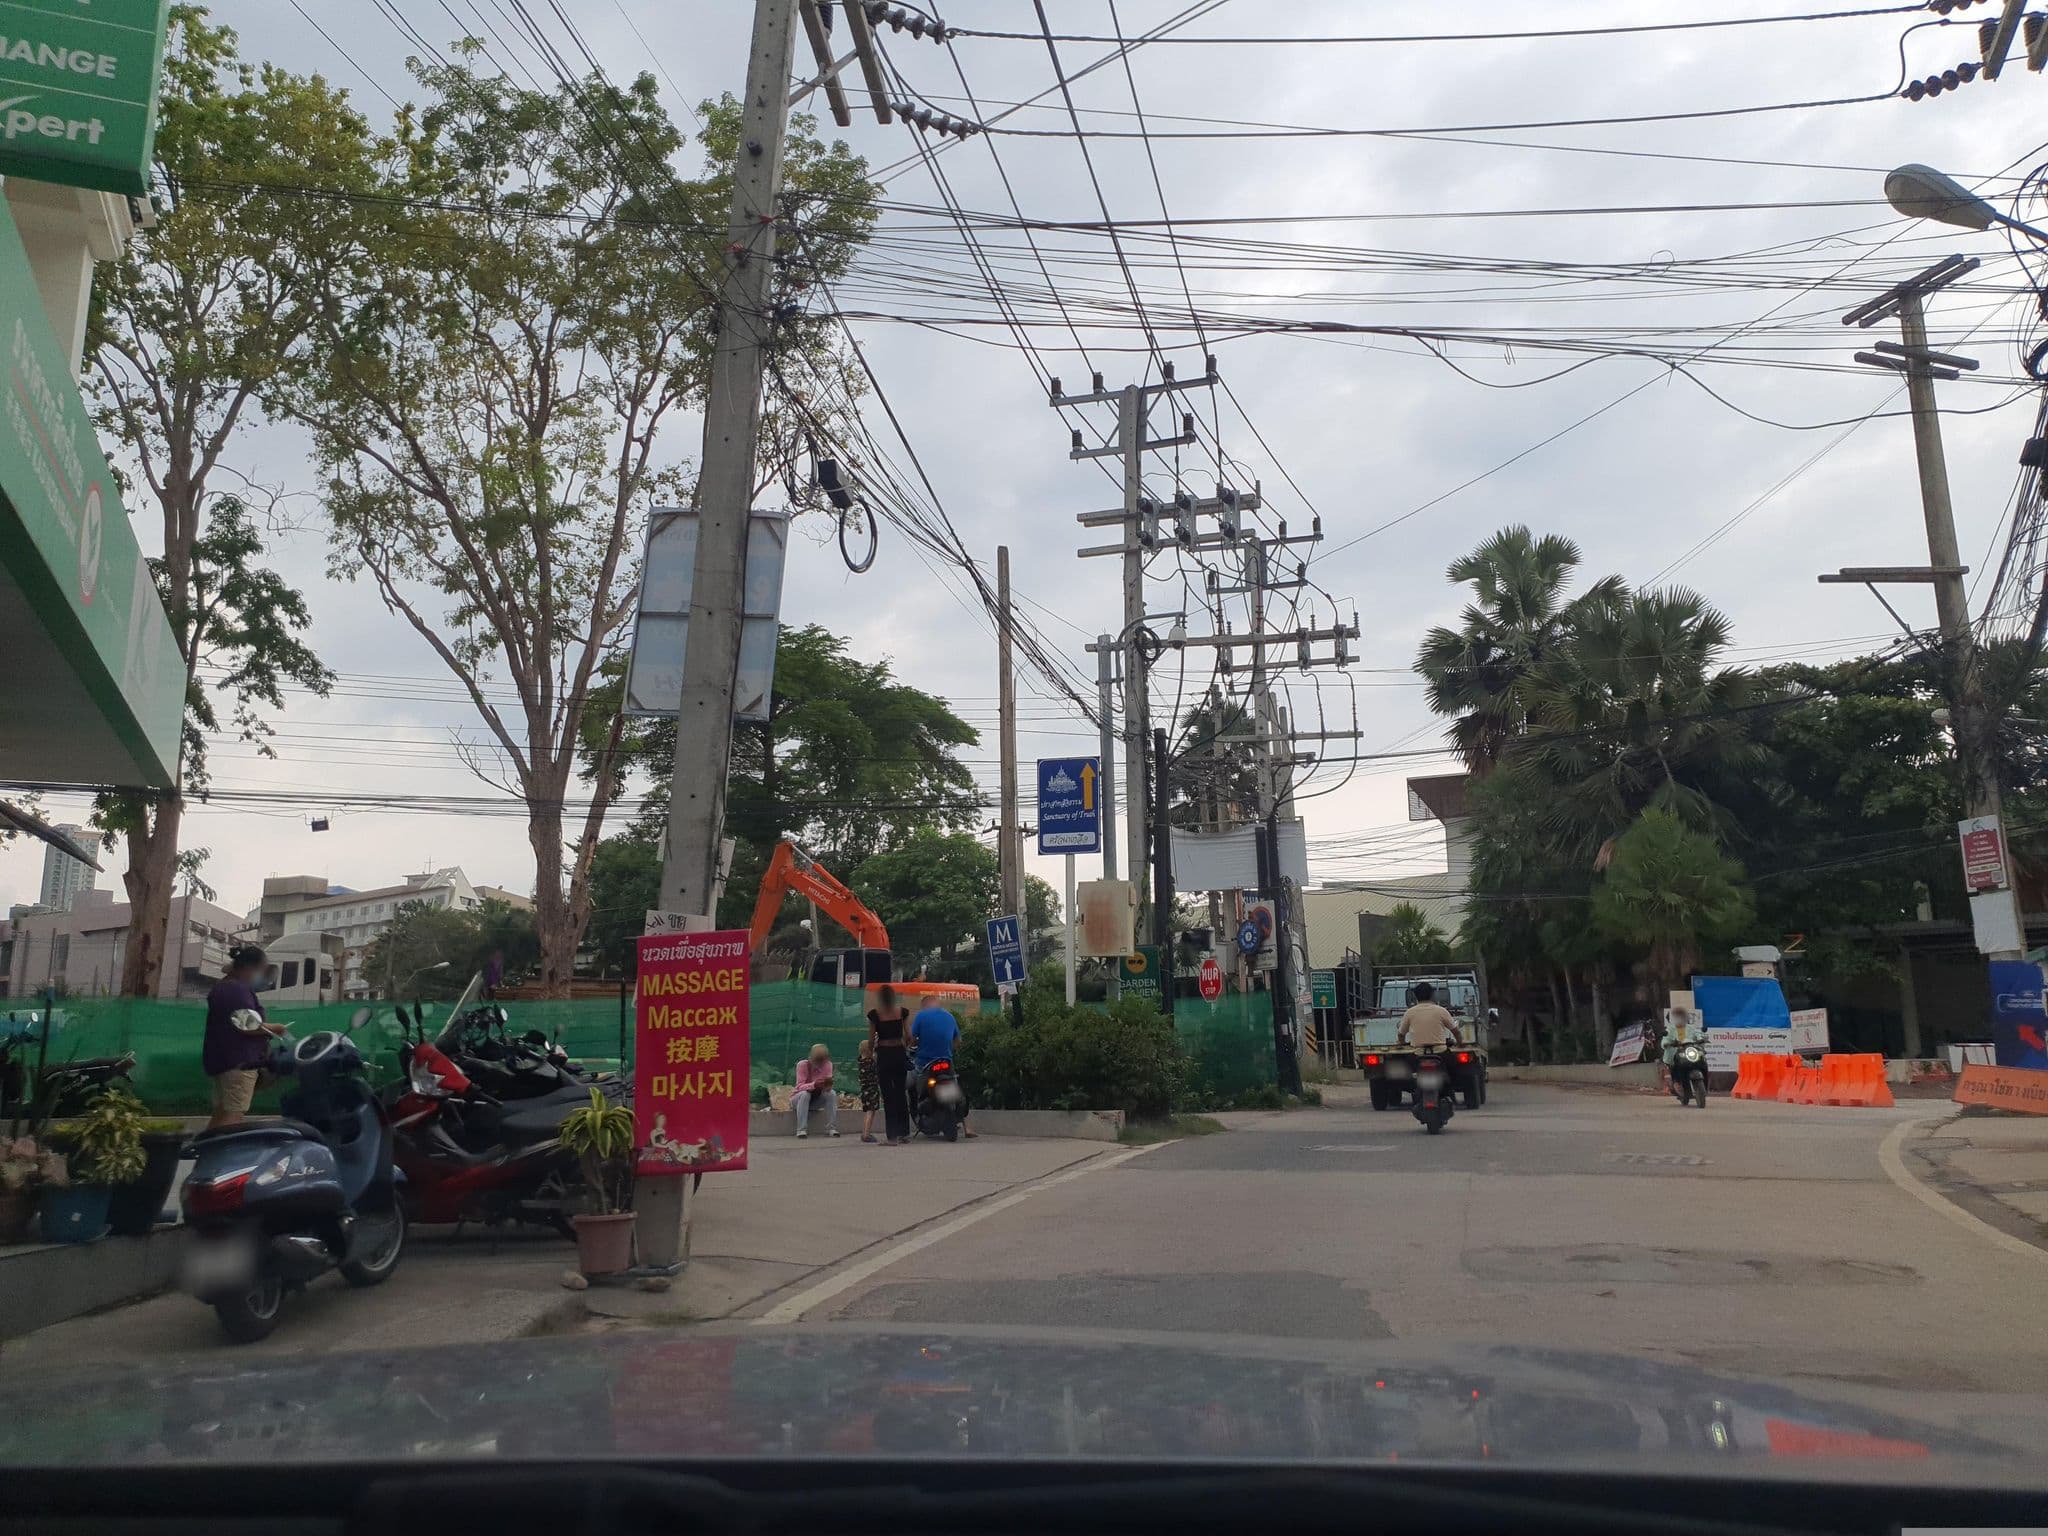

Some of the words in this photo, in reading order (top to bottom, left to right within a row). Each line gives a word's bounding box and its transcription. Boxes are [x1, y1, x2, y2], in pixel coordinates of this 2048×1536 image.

[1042, 812, 1070, 822] Sanctuary
[1071, 810, 1078, 821] of
[996, 923, 1012, 944] M
[642, 936, 744, 965] นวดเพื่อสุขภาพ
[643, 968, 744, 997] MASSAGE
[1205, 987, 1216, 995] STOP
[938, 990, 974, 1001] HITACHI
[647, 1005, 738, 1030] Массаж
[666, 1035, 720, 1064] 按摩
[652, 1069, 732, 1101] 마사지
